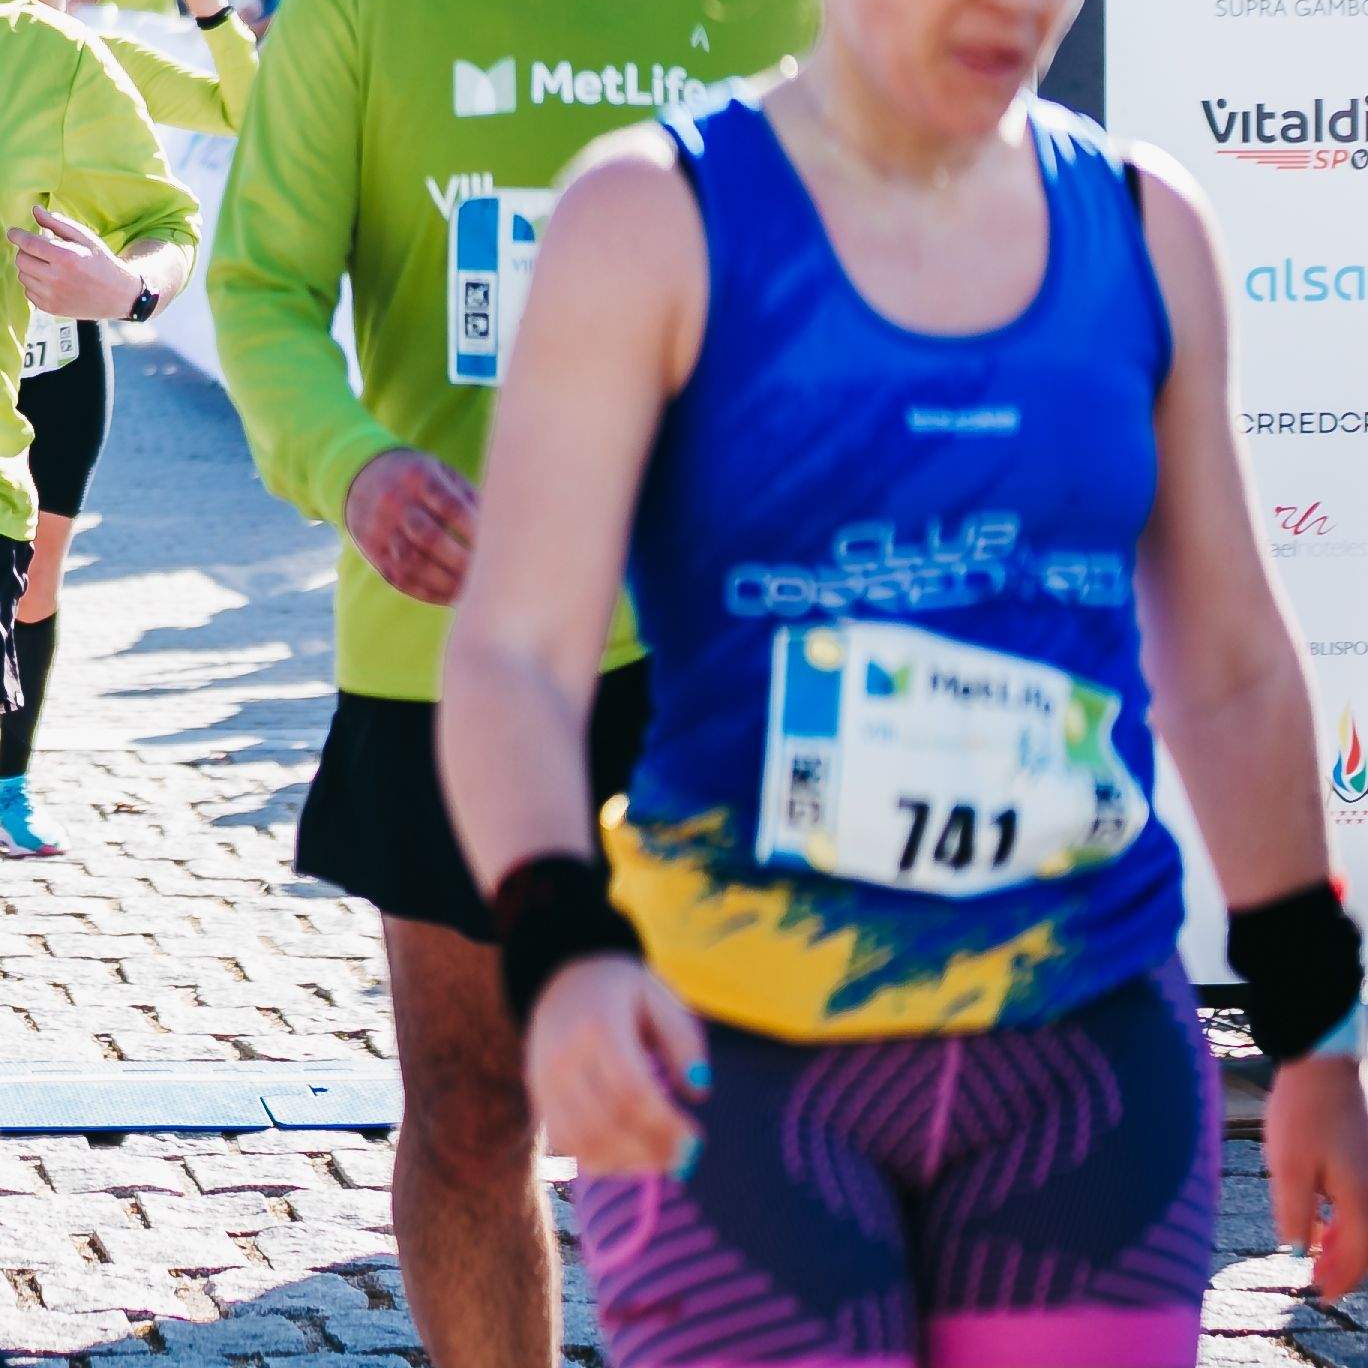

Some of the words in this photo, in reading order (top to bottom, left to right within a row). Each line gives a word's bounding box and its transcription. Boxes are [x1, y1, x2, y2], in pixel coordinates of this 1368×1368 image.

[530, 61, 706, 107] MetLife
[1245, 257, 1366, 302] alsa
[894, 796, 1021, 872] 741
